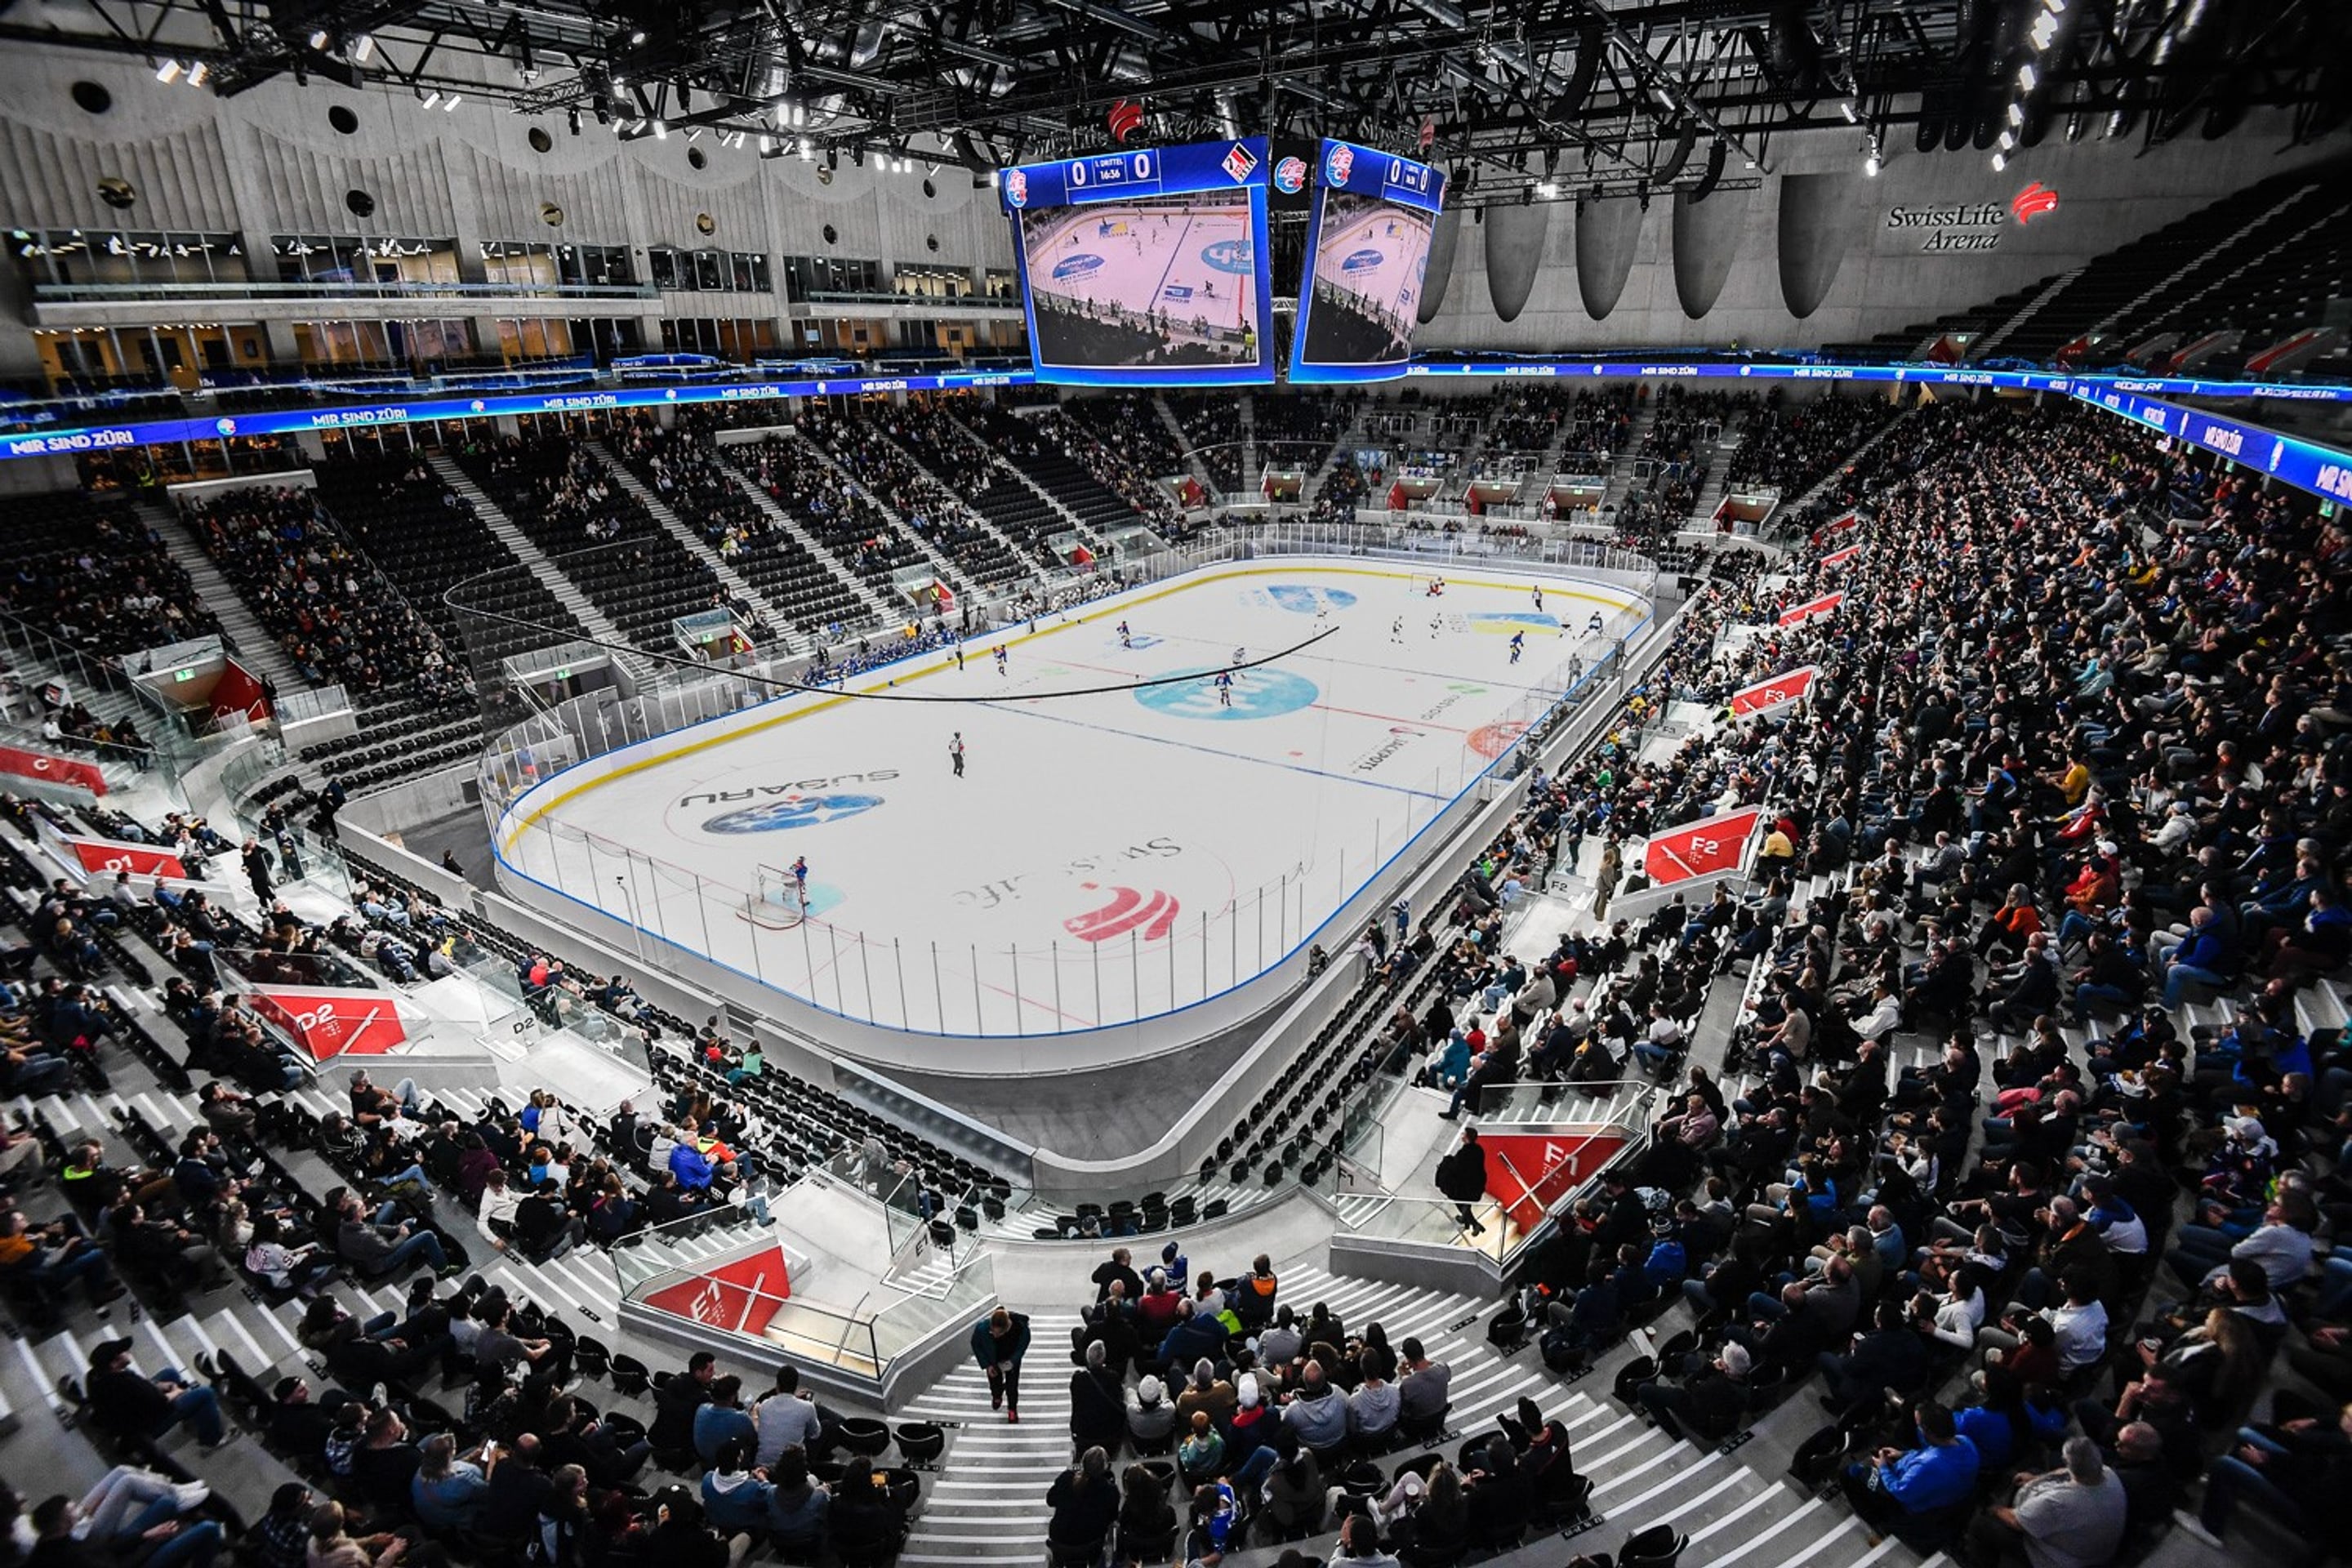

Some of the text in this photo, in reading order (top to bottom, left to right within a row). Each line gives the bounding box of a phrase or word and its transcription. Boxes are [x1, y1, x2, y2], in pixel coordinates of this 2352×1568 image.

[1072, 162, 1086, 186] 0
[1134, 154, 1151, 179] 0
[1391, 159, 1401, 183] 0
[1420, 169, 1428, 190] 0
[1888, 203, 2004, 228] SwissLife
[1922, 229, 2000, 251] Arena
[544, 393, 617, 410] MIR SIND ZÜRI
[721, 390, 737, 399] MIR
[738, 388, 759, 397] SIND
[312, 408, 408, 426] MIR SIND ZÜRI
[10, 429, 135, 455] MIR SIND ZÜRI
[1764, 689, 1786, 702] F3
[680, 769, 899, 808] SUBARU
[1690, 835, 1719, 856] F2
[105, 854, 134, 873] D1
[1551, 880, 1567, 893] F2
[295, 1003, 335, 1033] D2
[513, 1017, 534, 1035] D2
[1544, 1140, 1579, 1177] F1
[1339, 1165, 1354, 1187] F1
[915, 1232, 929, 1258] E1
[689, 1277, 721, 1322] E1
